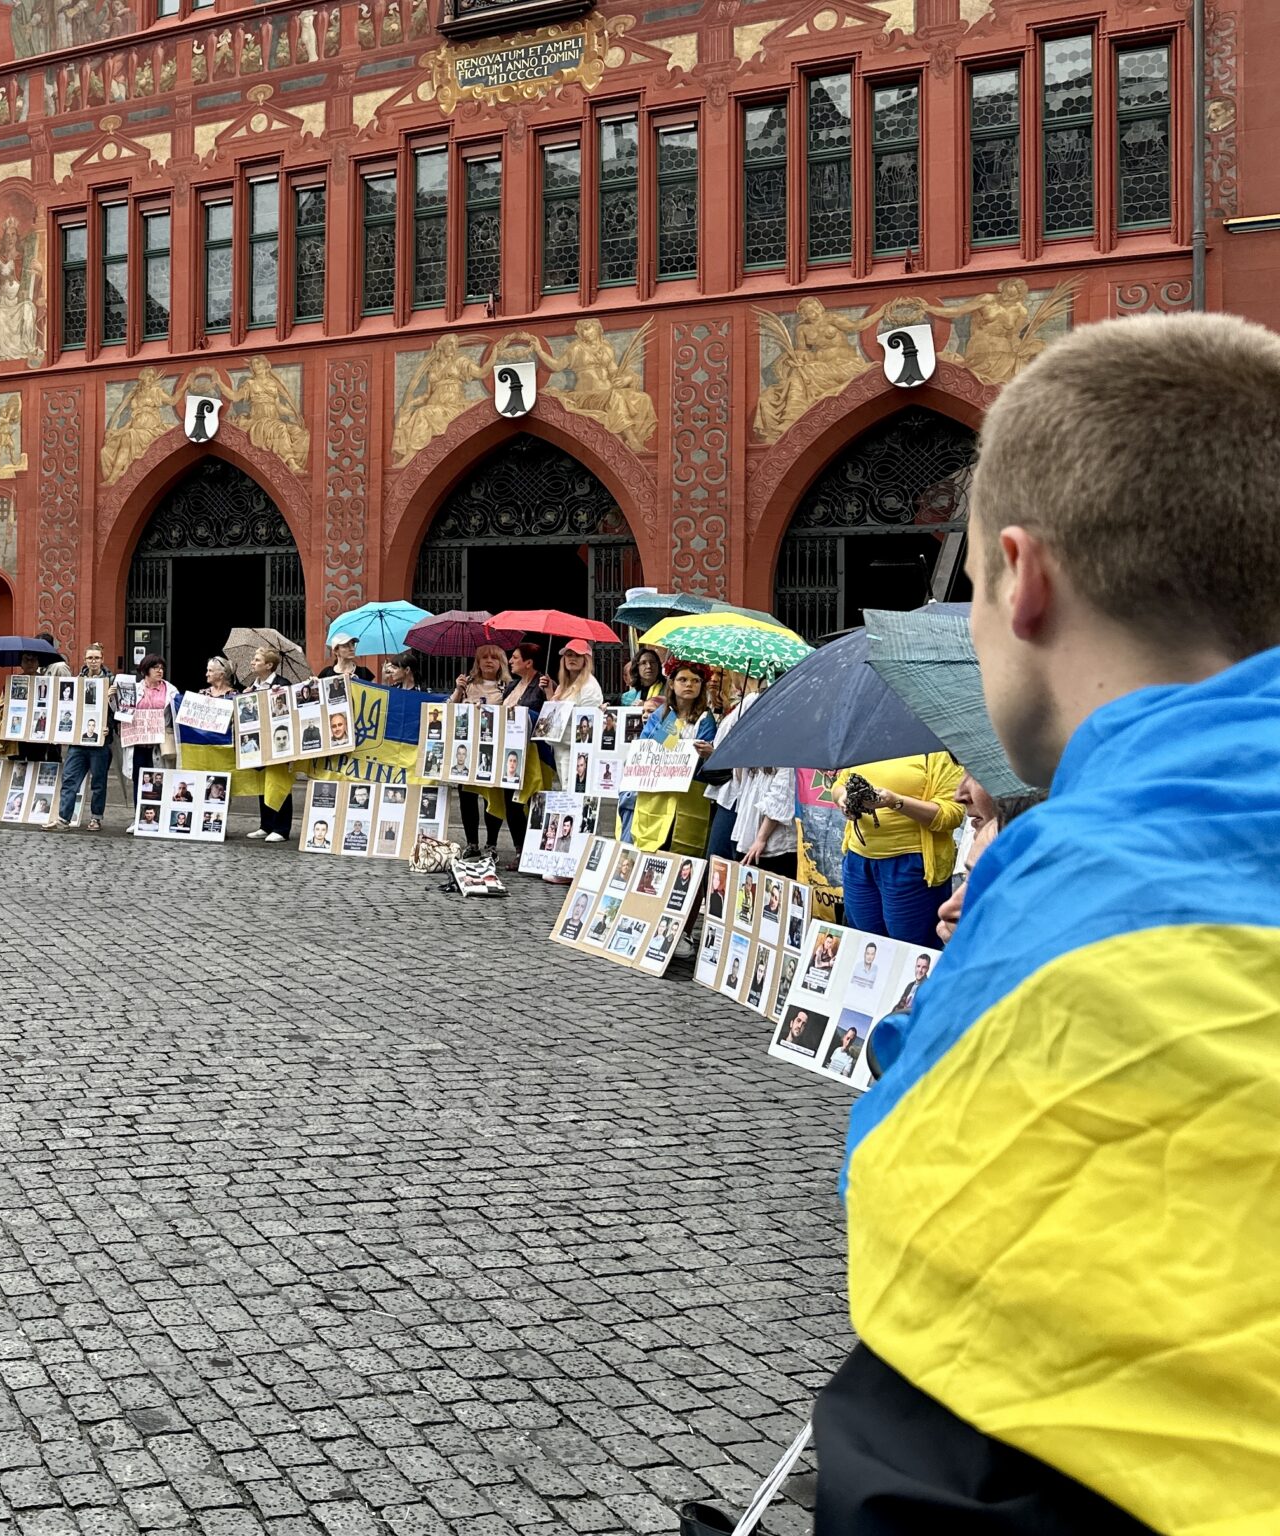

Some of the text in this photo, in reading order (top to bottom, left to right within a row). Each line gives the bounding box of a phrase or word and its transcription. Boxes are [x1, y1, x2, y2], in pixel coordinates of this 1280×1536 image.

[456, 38, 582, 71] RENOVATUM ET AMPLI
[458, 49, 579, 81] FICATUM ANNO DOMINI
